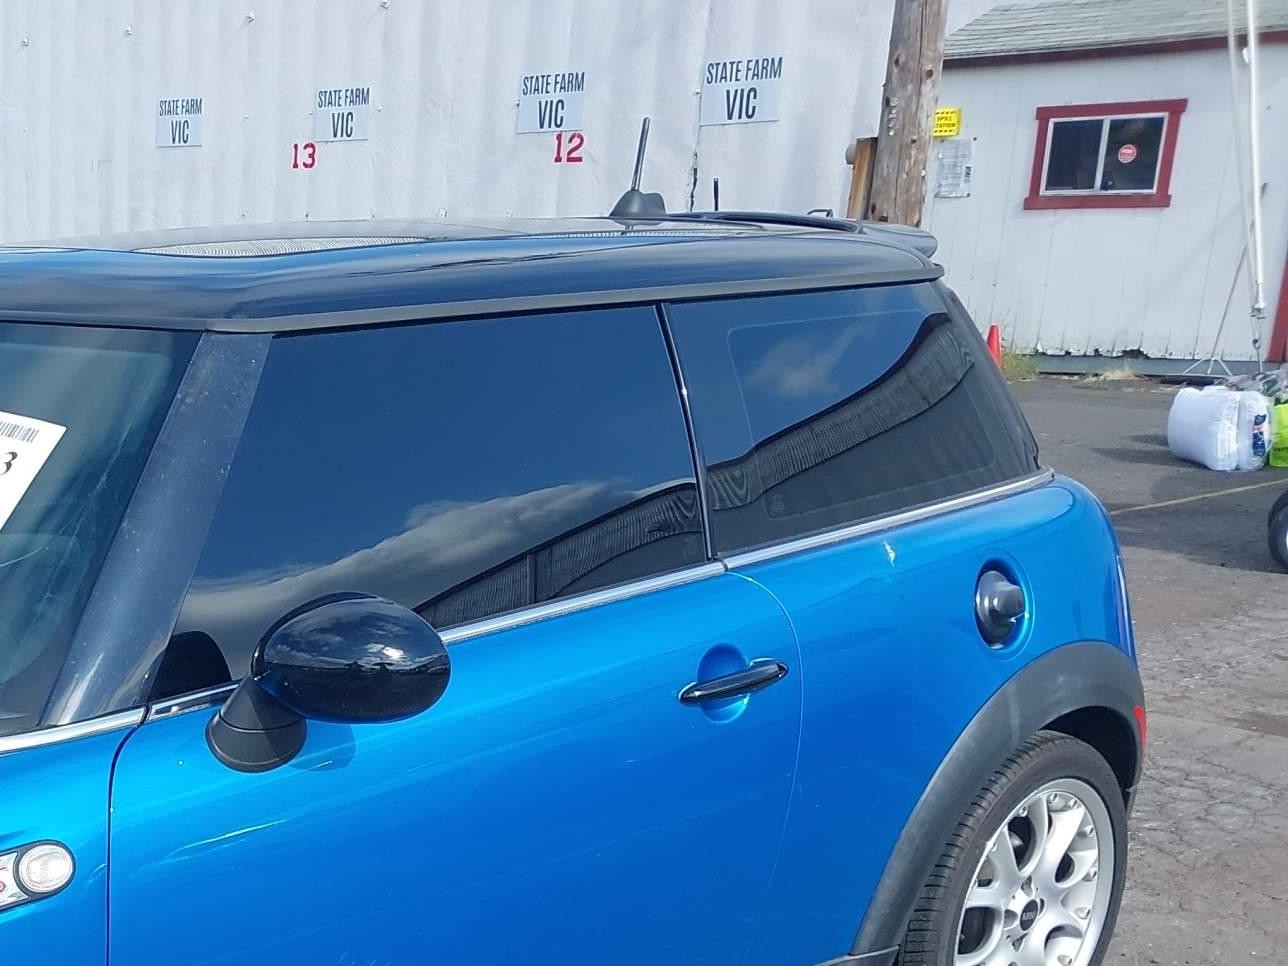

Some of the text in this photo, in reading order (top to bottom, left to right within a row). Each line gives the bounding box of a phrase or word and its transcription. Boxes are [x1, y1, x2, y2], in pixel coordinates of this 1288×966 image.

[522, 71, 585, 97] STATE FARM
[707, 56, 783, 85] STATE FARM
[159, 96, 203, 117] STATE FARM
[318, 86, 370, 109] STATE FARM
[724, 87, 758, 121] VIC
[331, 111, 354, 139] VIC
[537, 98, 566, 130] VIC
[170, 119, 190, 145] VIC
[291, 141, 318, 170] 13
[553, 132, 585, 164] 12
